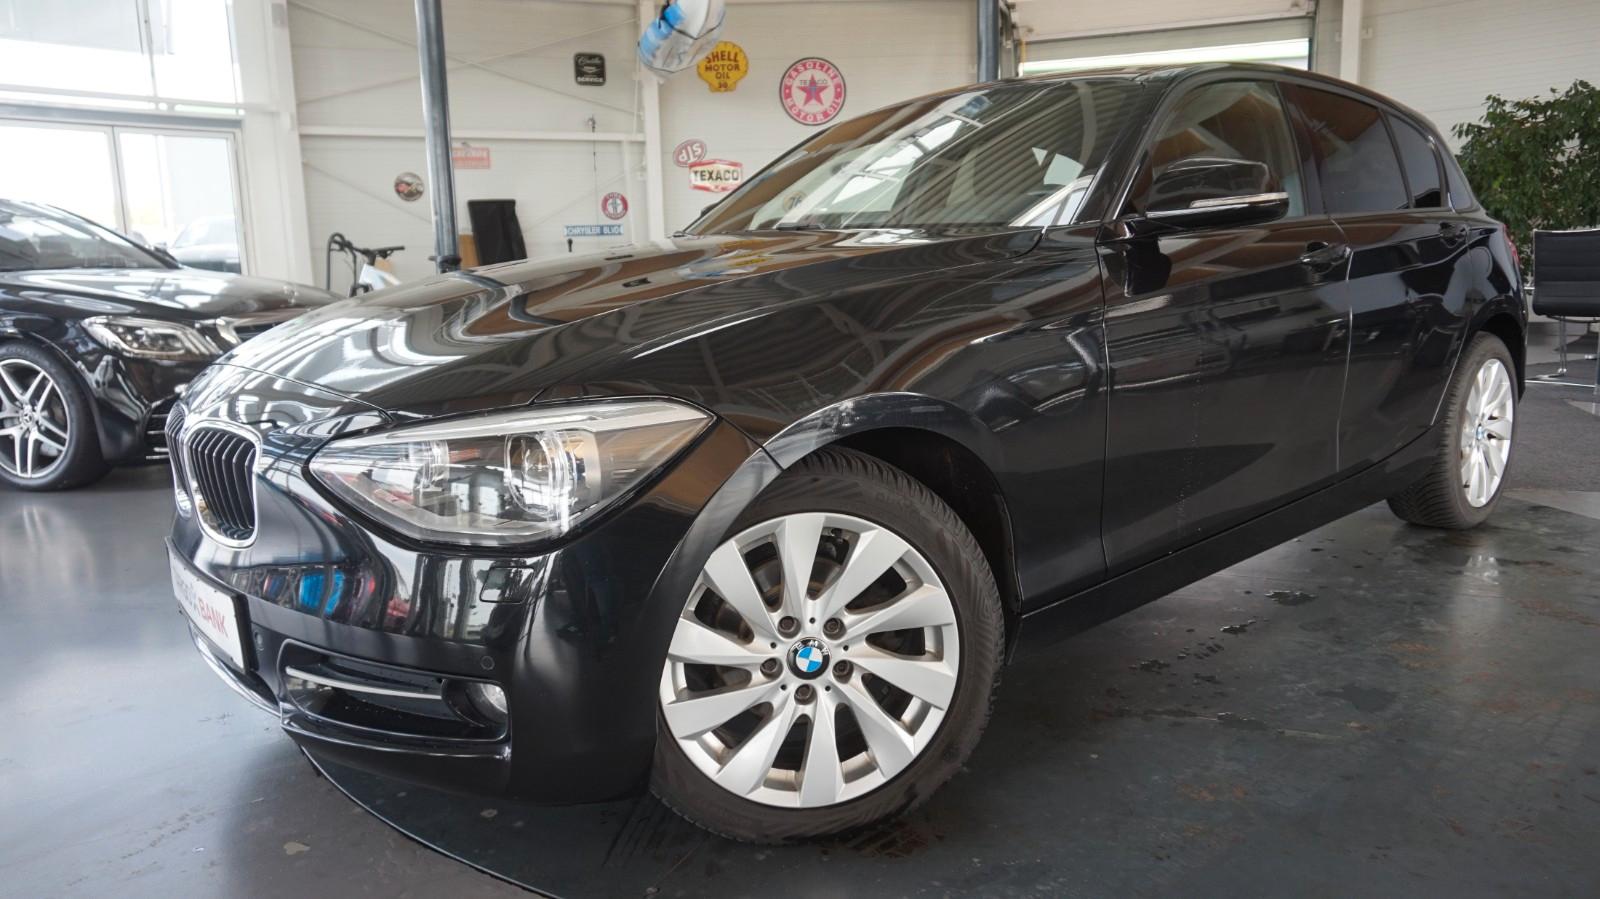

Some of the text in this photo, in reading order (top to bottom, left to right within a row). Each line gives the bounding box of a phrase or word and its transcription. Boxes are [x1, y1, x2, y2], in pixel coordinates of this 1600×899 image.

[705, 50, 739, 64] SHELL
[705, 63, 741, 72] MOTOR
[784, 61, 841, 87] GASOLINE
[715, 71, 730, 80] OIL
[785, 98, 825, 122] MOTOR
[693, 169, 739, 182] TEXACO
